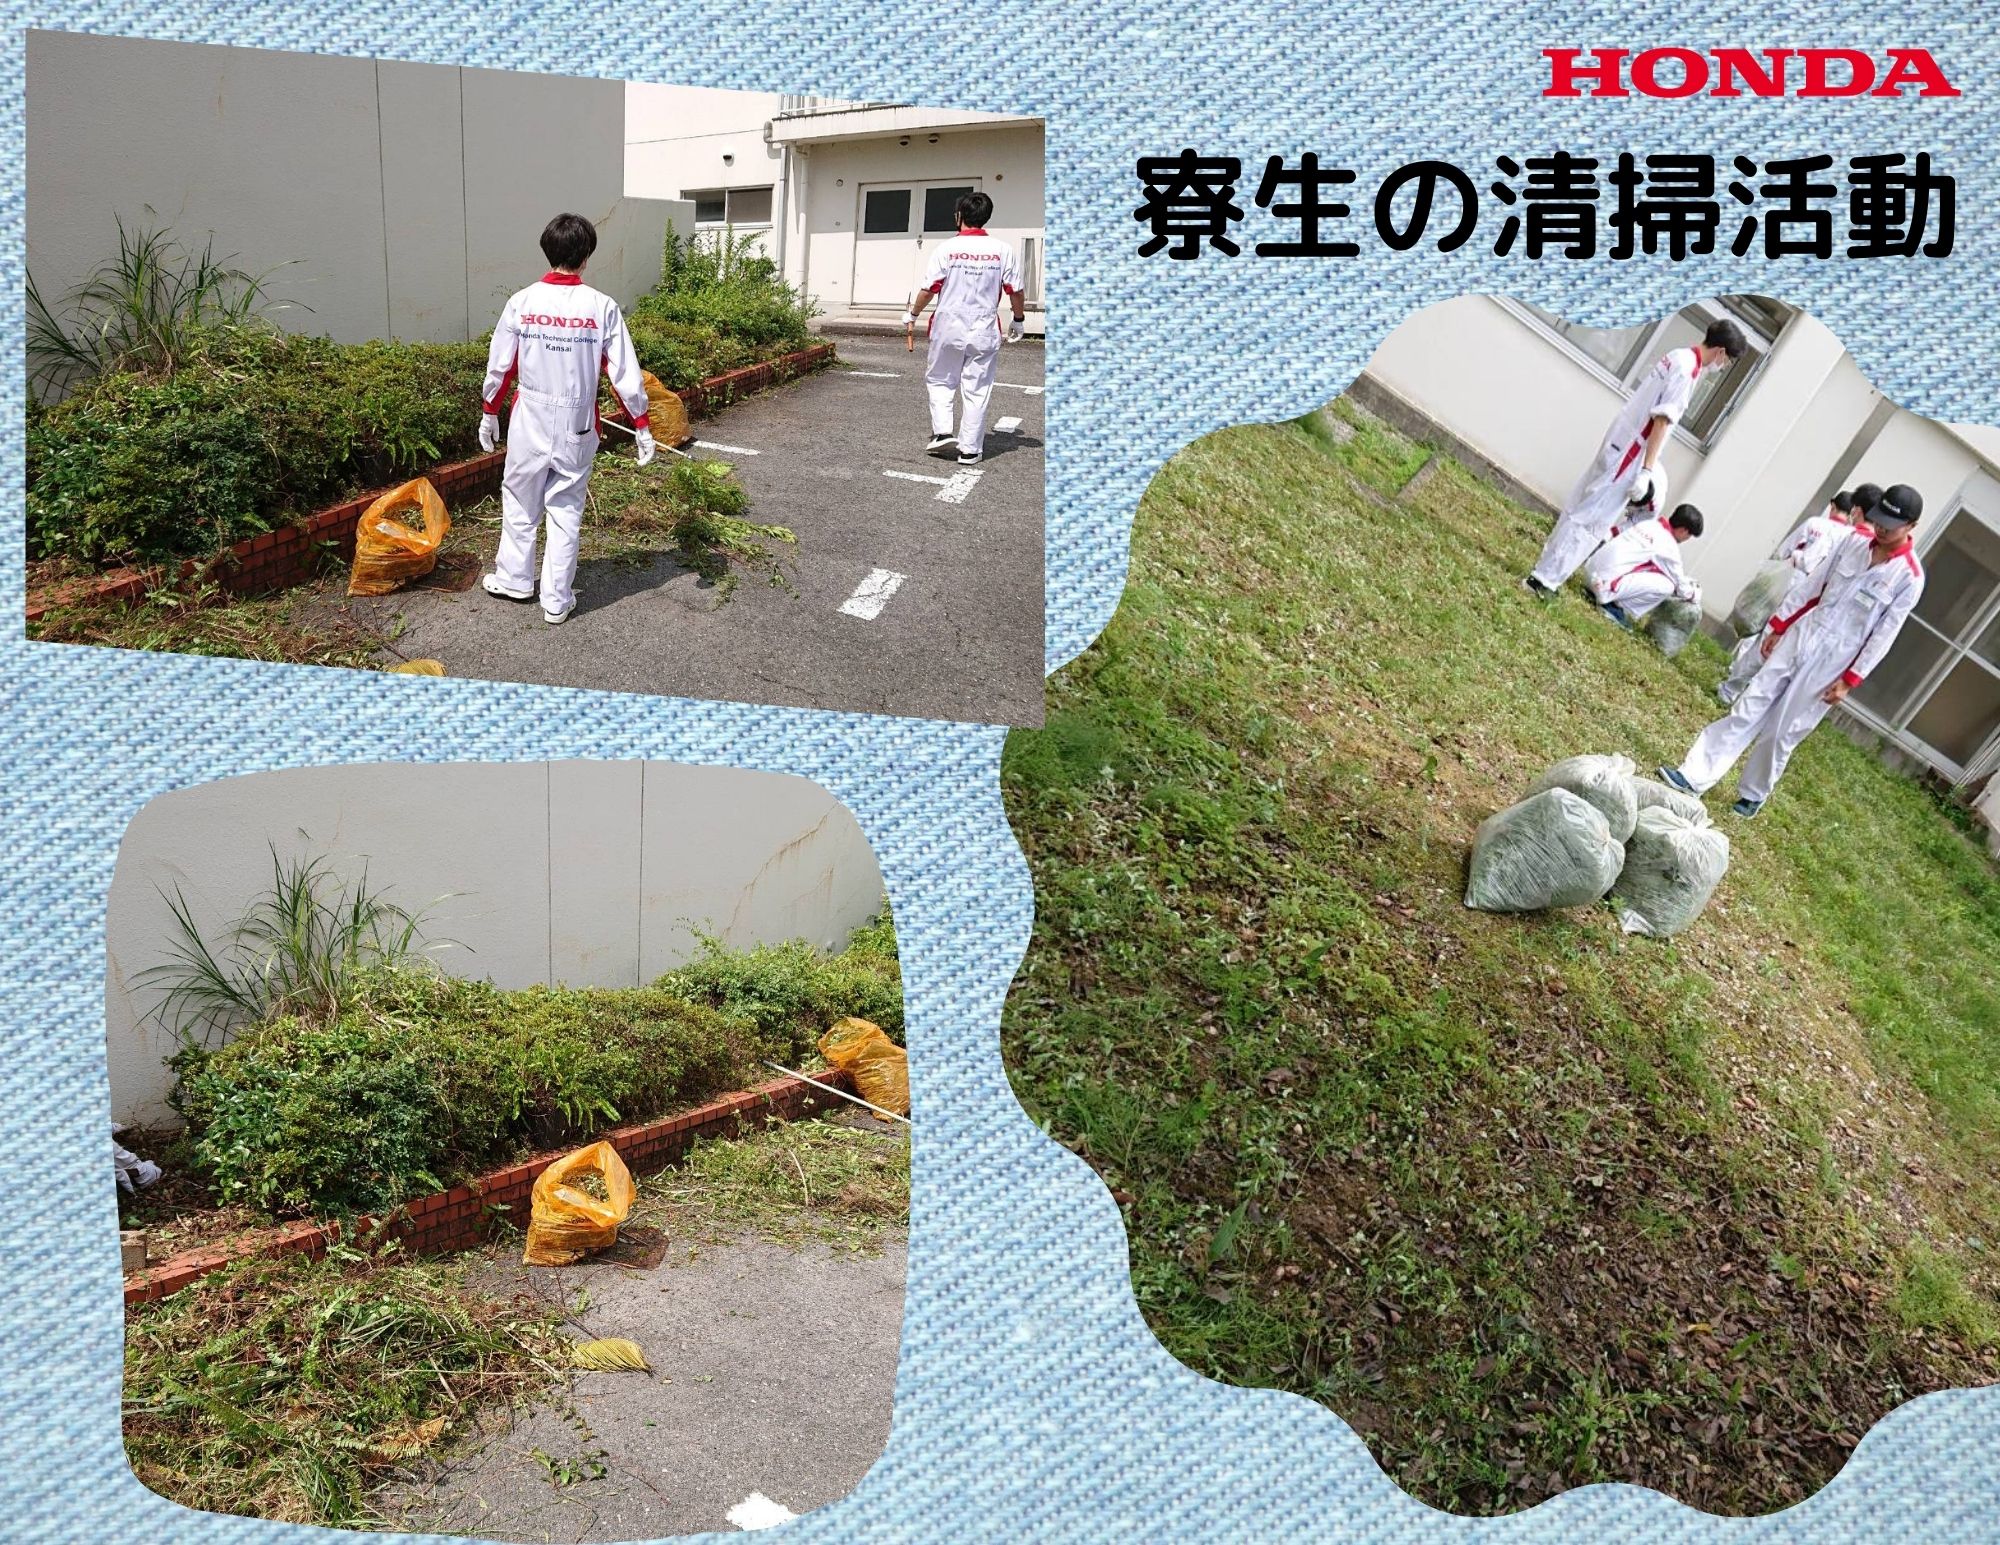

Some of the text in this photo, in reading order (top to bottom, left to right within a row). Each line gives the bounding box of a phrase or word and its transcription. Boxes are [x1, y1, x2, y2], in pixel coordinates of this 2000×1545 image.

[949, 252, 1001, 261] HONDA
[521, 313, 598, 330] HONDA
[542, 333, 573, 343] Technical
[573, 336, 598, 345] College
[545, 343, 572, 353] Kansai
